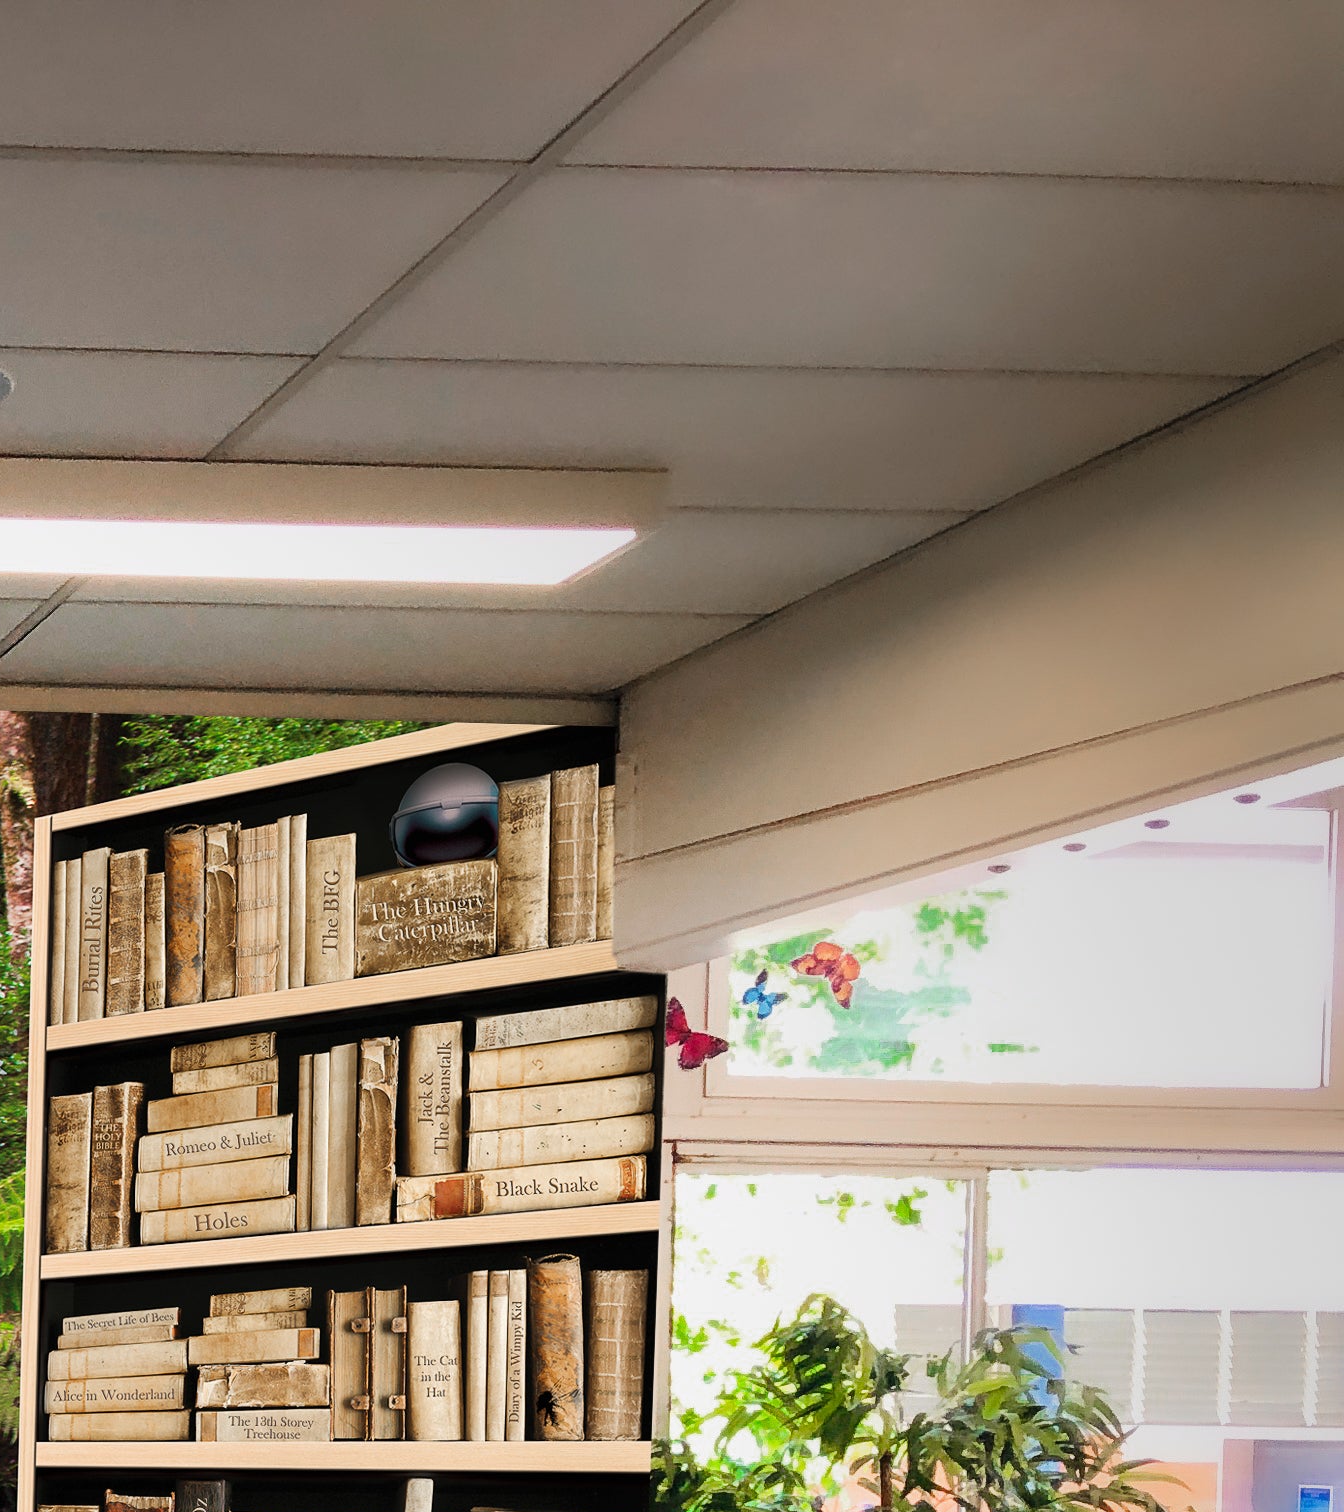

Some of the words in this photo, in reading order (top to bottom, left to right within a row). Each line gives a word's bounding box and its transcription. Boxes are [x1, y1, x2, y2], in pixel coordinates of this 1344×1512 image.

[323, 869, 340, 913] BFG
[84, 886, 103, 931] Rites
[366, 902, 407, 921] The
[413, 895, 485, 916] Hungry
[322, 918, 339, 955] The
[378, 915, 479, 942] Caterpillar
[82, 938, 101, 993] Burial
[420, 1071, 434, 1085] &
[436, 1040, 452, 1117] Beanstalk
[417, 1090, 433, 1126] Jack
[95, 1132, 122, 1141] HOLY
[100, 1124, 119, 1132] THE
[434, 1121, 449, 1155] The
[96, 1142, 120, 1150] BIBLE
[165, 1140, 217, 1157] Romeo
[220, 1135, 233, 1149] &
[234, 1131, 272, 1149] Juliet
[496, 1179, 542, 1197] Black
[548, 1176, 599, 1194] Snake
[193, 1211, 248, 1232] Holes
[65, 1321, 85, 1331] The
[87, 1319, 116, 1329] Secret
[119, 1315, 137, 1326] Life
[139, 1313, 150, 1323] of
[151, 1312, 174, 1323] Bees
[511, 1301, 523, 1321] Kid
[510, 1324, 524, 1366] Wimpy
[414, 1355, 437, 1366] The
[439, 1355, 458, 1366] Cat
[420, 1372, 432, 1382] in
[434, 1371, 451, 1382] the
[509, 1377, 521, 1390] of
[53, 1390, 83, 1402] Alice
[86, 1389, 97, 1401] in
[101, 1388, 175, 1401] Wonderland
[426, 1387, 446, 1398] Hat
[509, 1393, 523, 1423] Diary
[228, 1415, 250, 1427] The
[254, 1416, 277, 1427] 13th
[280, 1416, 314, 1429] Storey
[243, 1428, 301, 1440] Treehouse
